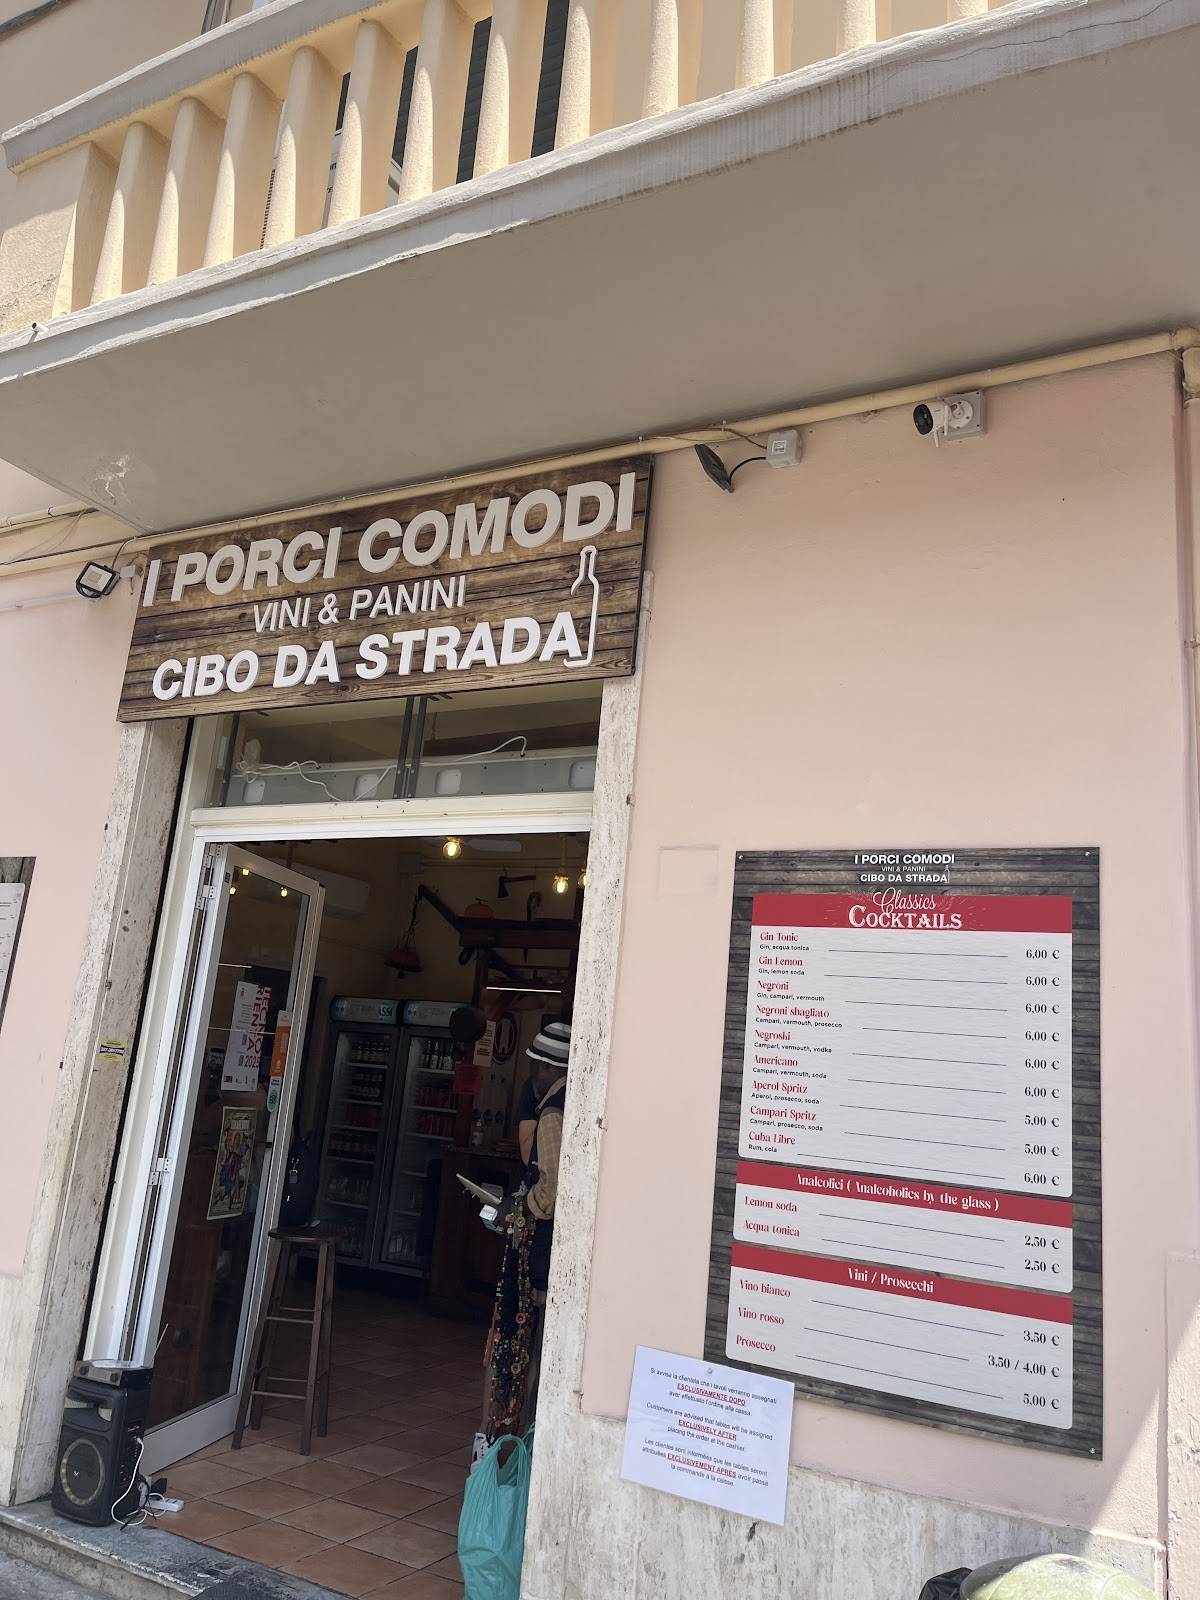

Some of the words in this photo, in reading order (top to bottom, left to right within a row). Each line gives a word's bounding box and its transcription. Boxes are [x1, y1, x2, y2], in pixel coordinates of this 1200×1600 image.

[143, 559, 160, 606] I
[172, 526, 342, 602] PORCI
[357, 472, 636, 575] COMODI
[253, 597, 311, 633] VINI
[318, 592, 339, 624] &
[350, 574, 466, 620] PANINI
[152, 649, 258, 700] CIBO
[273, 639, 340, 688] DA
[356, 611, 582, 680] STRADA
[854, 854, 858, 864] I
[862, 854, 899, 864] PORCI
[903, 854, 955, 864] COMODI
[873, 887, 937, 914] Classics
[849, 905, 962, 929] COCKTAILS
[760, 932, 773, 941] Gin
[777, 932, 798, 941] Tonic
[759, 956, 772, 965] Gin
[775, 957, 803, 966] Lemon
[1052, 950, 1060, 959] €
[758, 981, 789, 991] Negroni
[1052, 977, 1060, 987] €
[757, 1005, 788, 1016] Negroni
[790, 1007, 829, 1019] sbagliato
[1052, 1004, 1060, 1014] €
[755, 1030, 791, 1041] Negroshi
[1052, 1032, 1060, 1042] €
[754, 1055, 798, 1066] Americano
[1052, 1060, 1060, 1070] €
[752, 1080, 779, 1091] Aperol
[782, 1082, 808, 1094] Spritz
[1052, 1088, 1060, 1099] €
[750, 1105, 787, 1118] Campari
[790, 1109, 816, 1121] Spritz
[1052, 1117, 1060, 1128] €
[748, 1131, 770, 1141] Cuba
[774, 1133, 795, 1144] Libre
[1052, 1146, 1060, 1157] €
[1052, 1175, 1060, 1186] €
[796, 1173, 844, 1191] Analcolici
[846, 1179, 851, 1192] (
[855, 1181, 920, 1201] Analcoholics
[923, 1189, 935, 1204] by
[940, 1193, 958, 1205] the
[962, 1195, 992, 1210] glass
[994, 1198, 999, 1212] )
[745, 1196, 773, 1208] Lemon
[775, 1200, 797, 1212] soda
[744, 1220, 769, 1233] Acqua
[772, 1224, 800, 1237] tonica
[1051, 1239, 1060, 1250] €
[1051, 1263, 1060, 1274] €
[848, 1268, 868, 1282] Vini
[871, 1272, 877, 1283] /
[880, 1274, 934, 1293] Prosecchi
[739, 1279, 758, 1291] Vino
[760, 1283, 791, 1298] bianco
[738, 1307, 757, 1319] Vino
[759, 1312, 785, 1325] rosso
[736, 1335, 776, 1352] Prosecco
[1051, 1335, 1060, 1346] €
[1014, 1359, 1019, 1371] /
[1051, 1367, 1060, 1378] €
[677, 1383, 728, 1401] ESCLUSIVAMENTE
[729, 1396, 745, 1406] DOPO
[1051, 1399, 1060, 1410] €
[646, 1402, 673, 1414] Customers
[684, 1412, 703, 1421] advised
[749, 1430, 772, 1440] assigned
[668, 1426, 685, 1436] placing
[678, 1419, 716, 1435] EXCLUSIVELY
[717, 1430, 736, 1441] AFTER
[667, 1453, 716, 1472] EXCLUSIVEMENT
